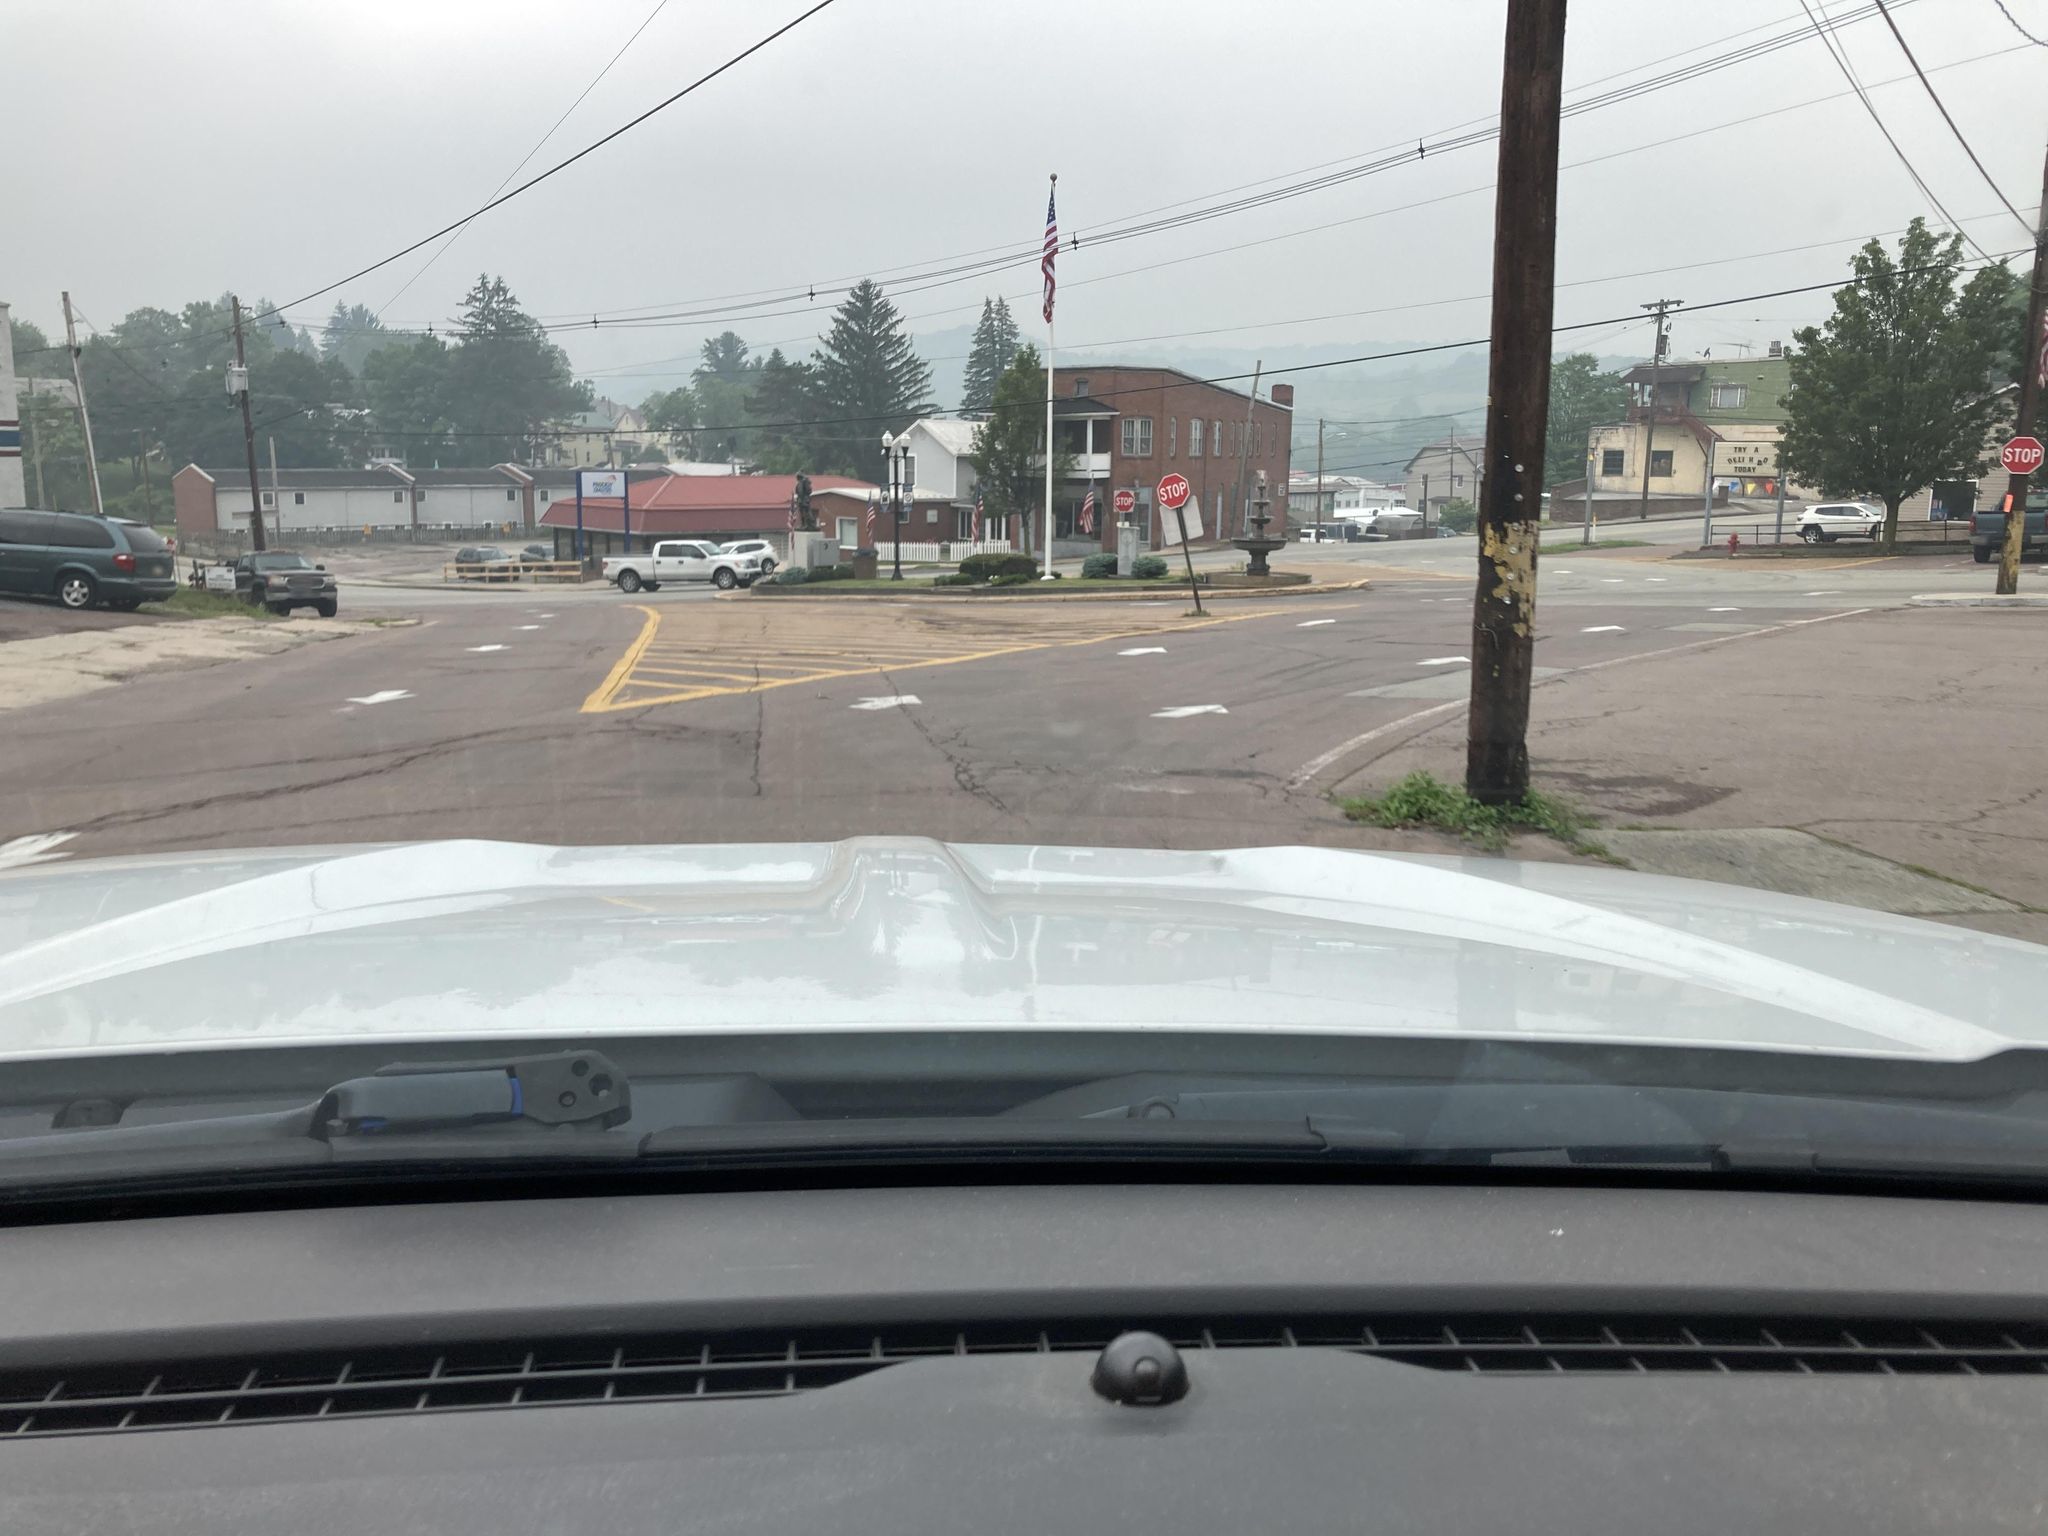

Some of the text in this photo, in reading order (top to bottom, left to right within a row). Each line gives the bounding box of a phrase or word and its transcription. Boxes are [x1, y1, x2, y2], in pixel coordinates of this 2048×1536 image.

[2004, 448, 2041, 463] STOP
[1159, 481, 1187, 501] STOP
[1116, 497, 1133, 506] STOP
